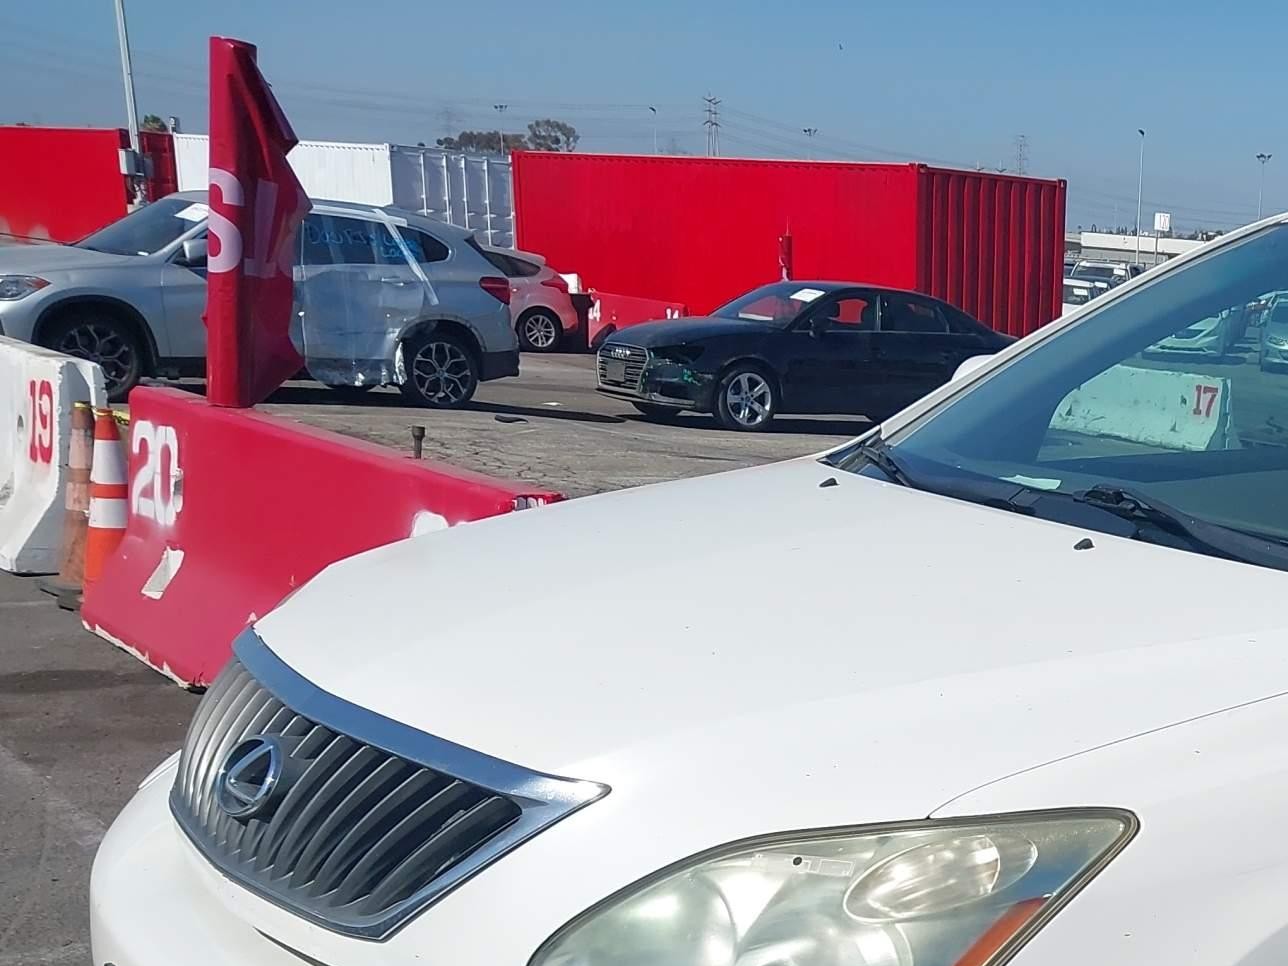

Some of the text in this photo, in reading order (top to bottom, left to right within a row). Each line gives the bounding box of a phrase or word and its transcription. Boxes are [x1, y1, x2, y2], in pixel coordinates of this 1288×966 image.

[29, 379, 54, 464] 19
[1193, 384, 1219, 418] 17
[132, 420, 180, 526] 20
